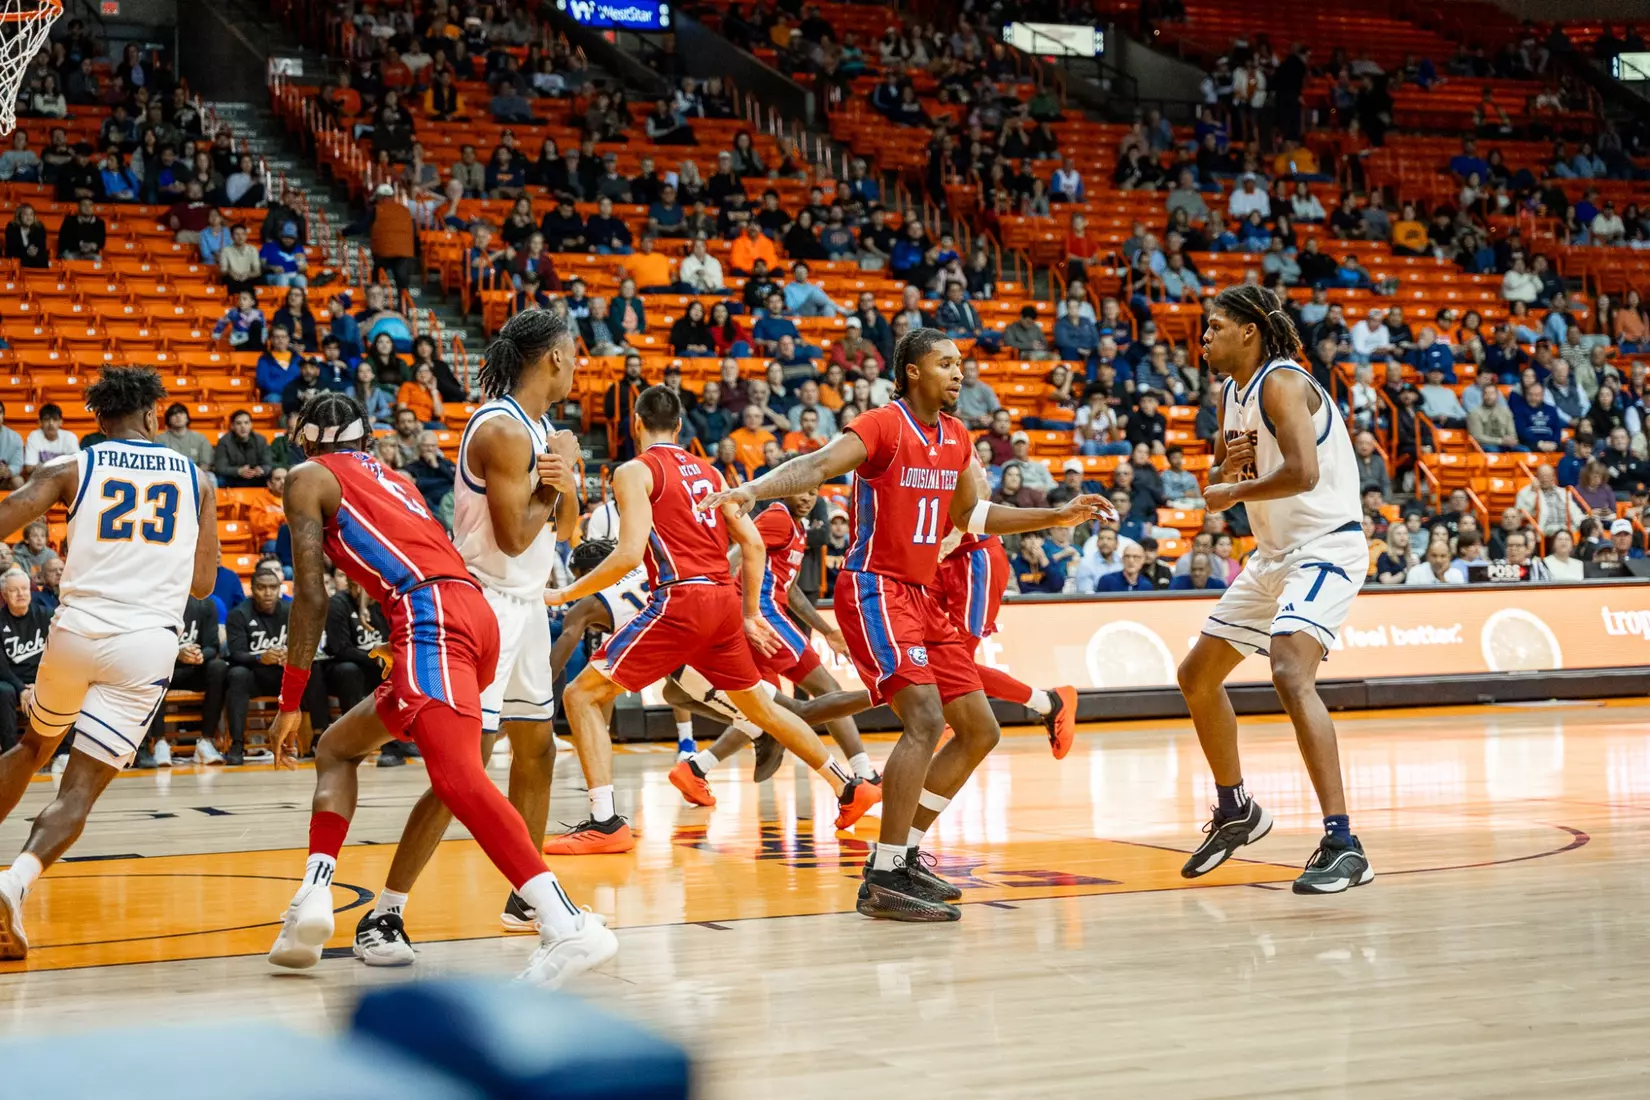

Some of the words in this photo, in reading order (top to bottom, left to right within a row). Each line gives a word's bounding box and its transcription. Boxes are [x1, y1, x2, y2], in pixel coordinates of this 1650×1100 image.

[98, 450, 166, 471] FRAZIER
[168, 456, 187, 473] III
[940, 469, 959, 490] TECH
[96, 476, 181, 546] 23
[912, 496, 940, 544] 11
[4, 628, 45, 660] Tech
[1344, 625, 1389, 648] feel
